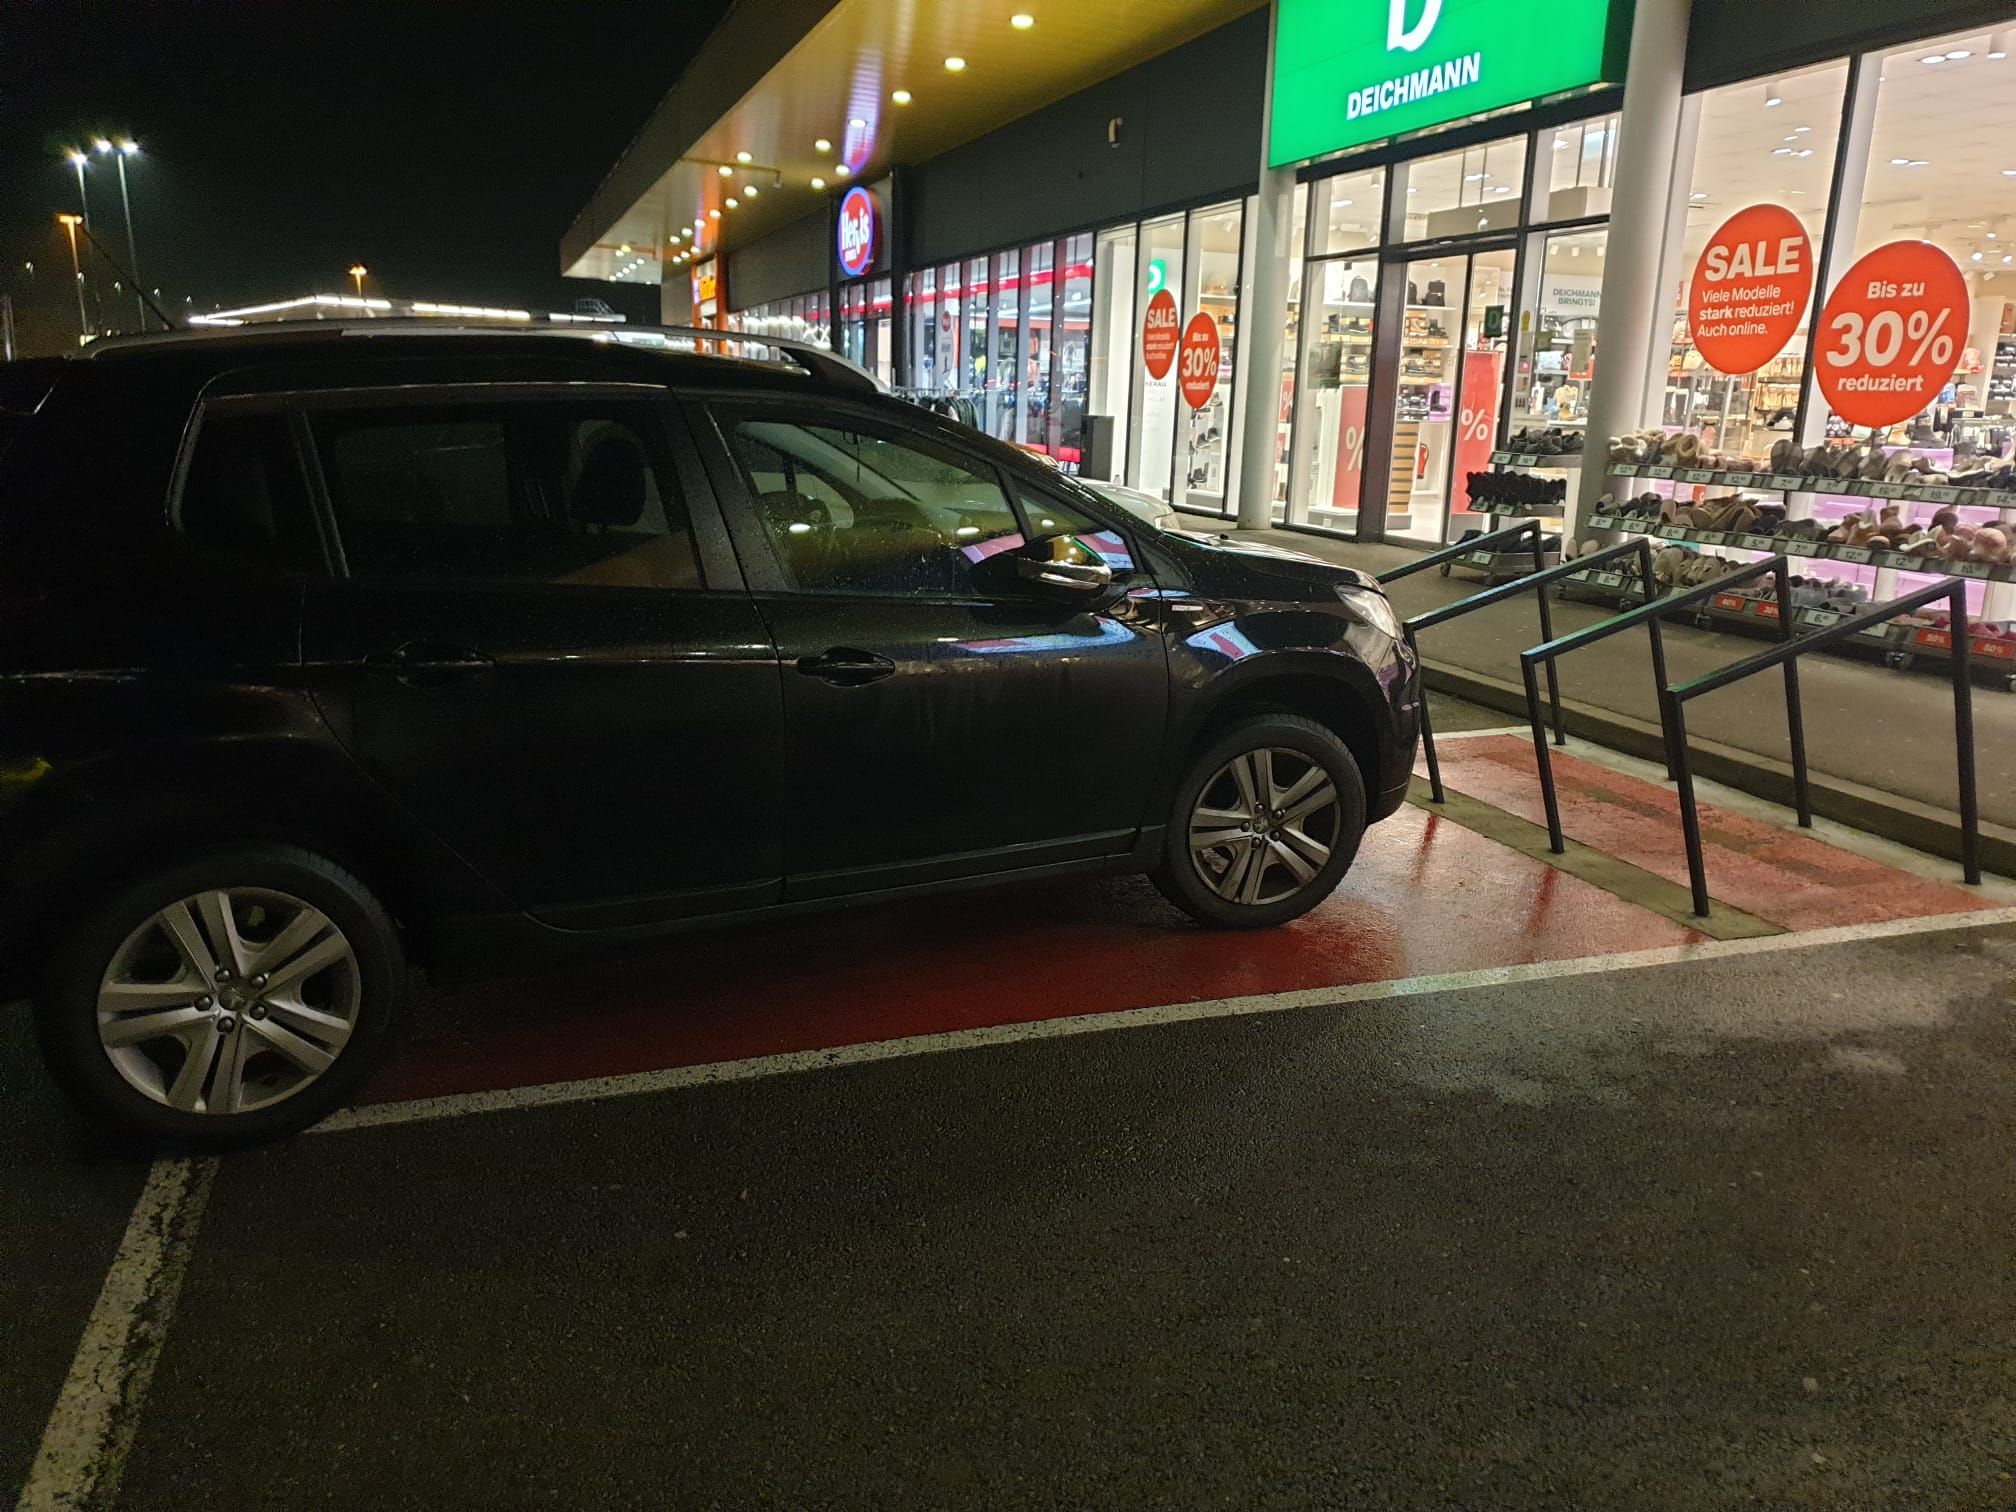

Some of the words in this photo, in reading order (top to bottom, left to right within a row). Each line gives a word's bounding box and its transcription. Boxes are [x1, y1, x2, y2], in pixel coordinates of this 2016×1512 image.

[1346, 52, 1481, 121] DEICHMANN
[1704, 236, 1804, 282] SALE
[1553, 288, 1601, 297] DEICHMANN
[1702, 288, 1731, 303] Viele
[1731, 284, 1781, 301] Modelle
[1867, 280, 1898, 299] Bis
[1900, 282, 1926, 297] zu
[1147, 307, 1176, 328] SALE
[1699, 305, 1734, 321] stark
[1734, 301, 1796, 318] reduziert!
[1697, 323, 1728, 337] Auch
[1728, 321, 1769, 336] online.
[1826, 308, 1953, 367] 30%
[1182, 347, 1217, 377] 30%
[1838, 374, 1925, 392] reduziert
[1461, 408, 1489, 441] %
